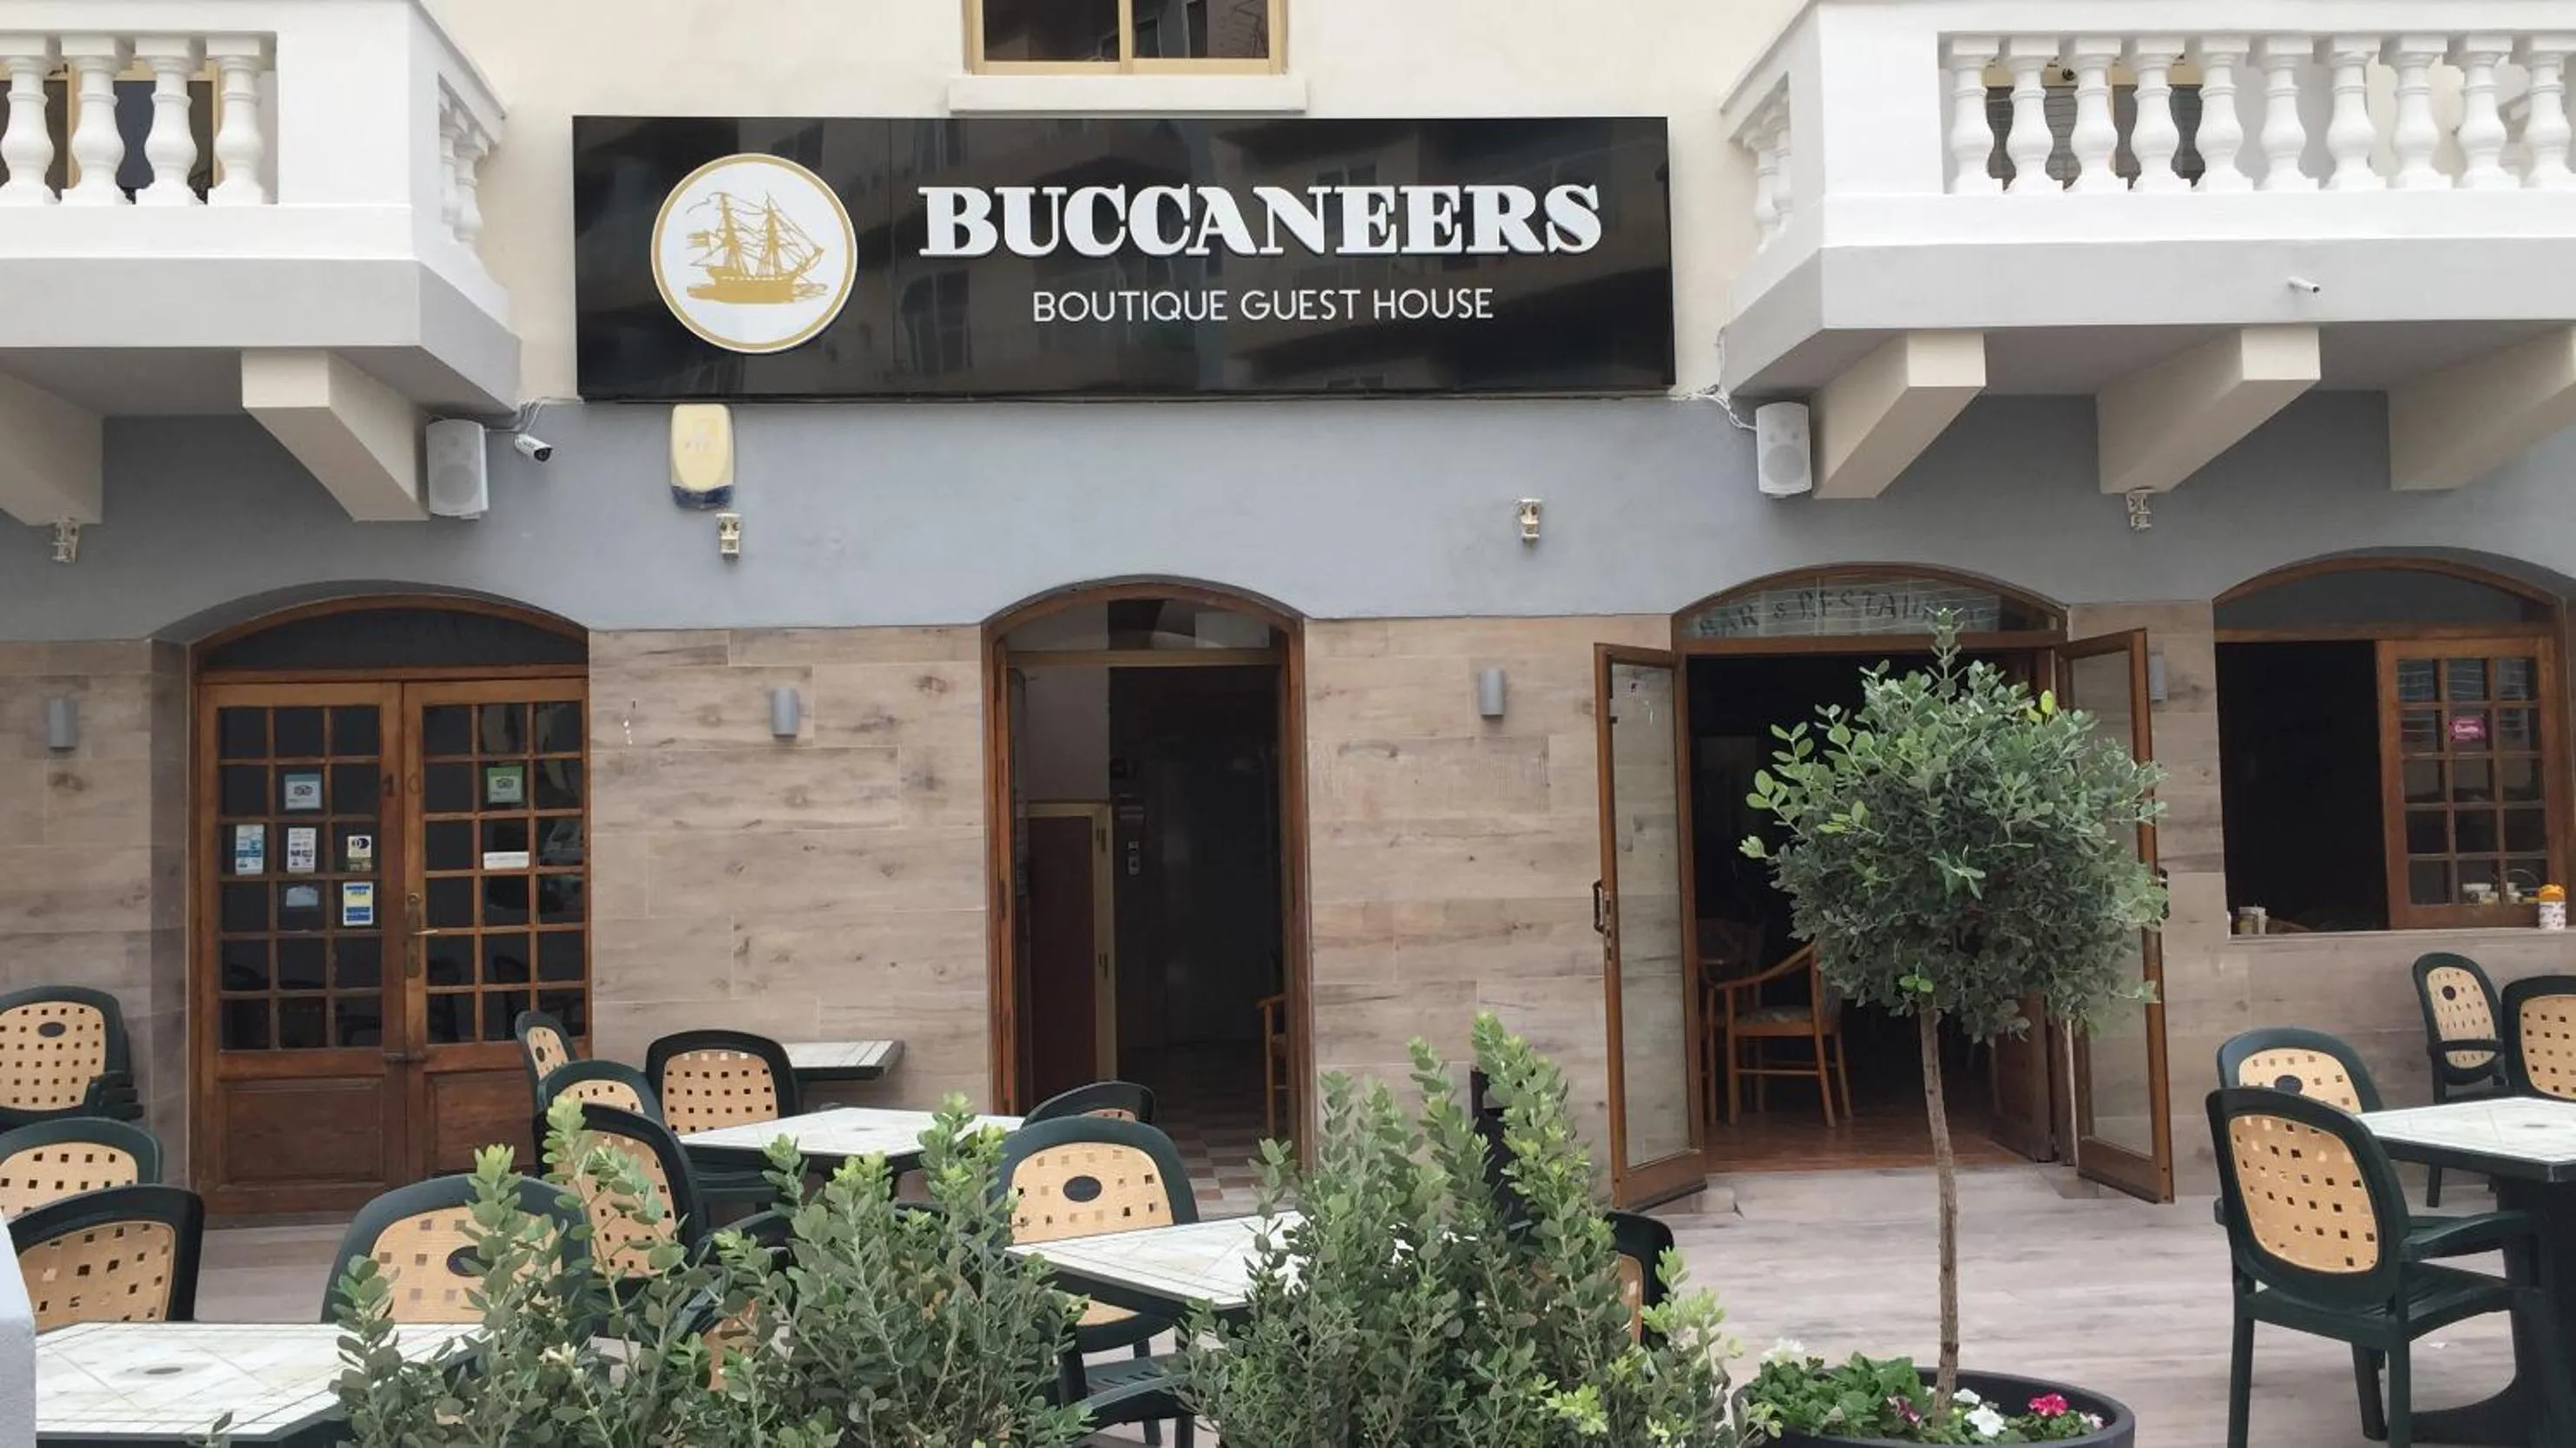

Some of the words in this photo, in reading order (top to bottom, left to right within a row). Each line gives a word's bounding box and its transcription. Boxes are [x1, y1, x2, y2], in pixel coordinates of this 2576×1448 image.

[917, 182, 1602, 258] BUCCANEERS
[1032, 290, 1228, 322] BOUTIQUE
[1239, 288, 1361, 320] GUEST
[1373, 287, 1494, 319] HOUSE
[1699, 603, 1759, 635] BAR
